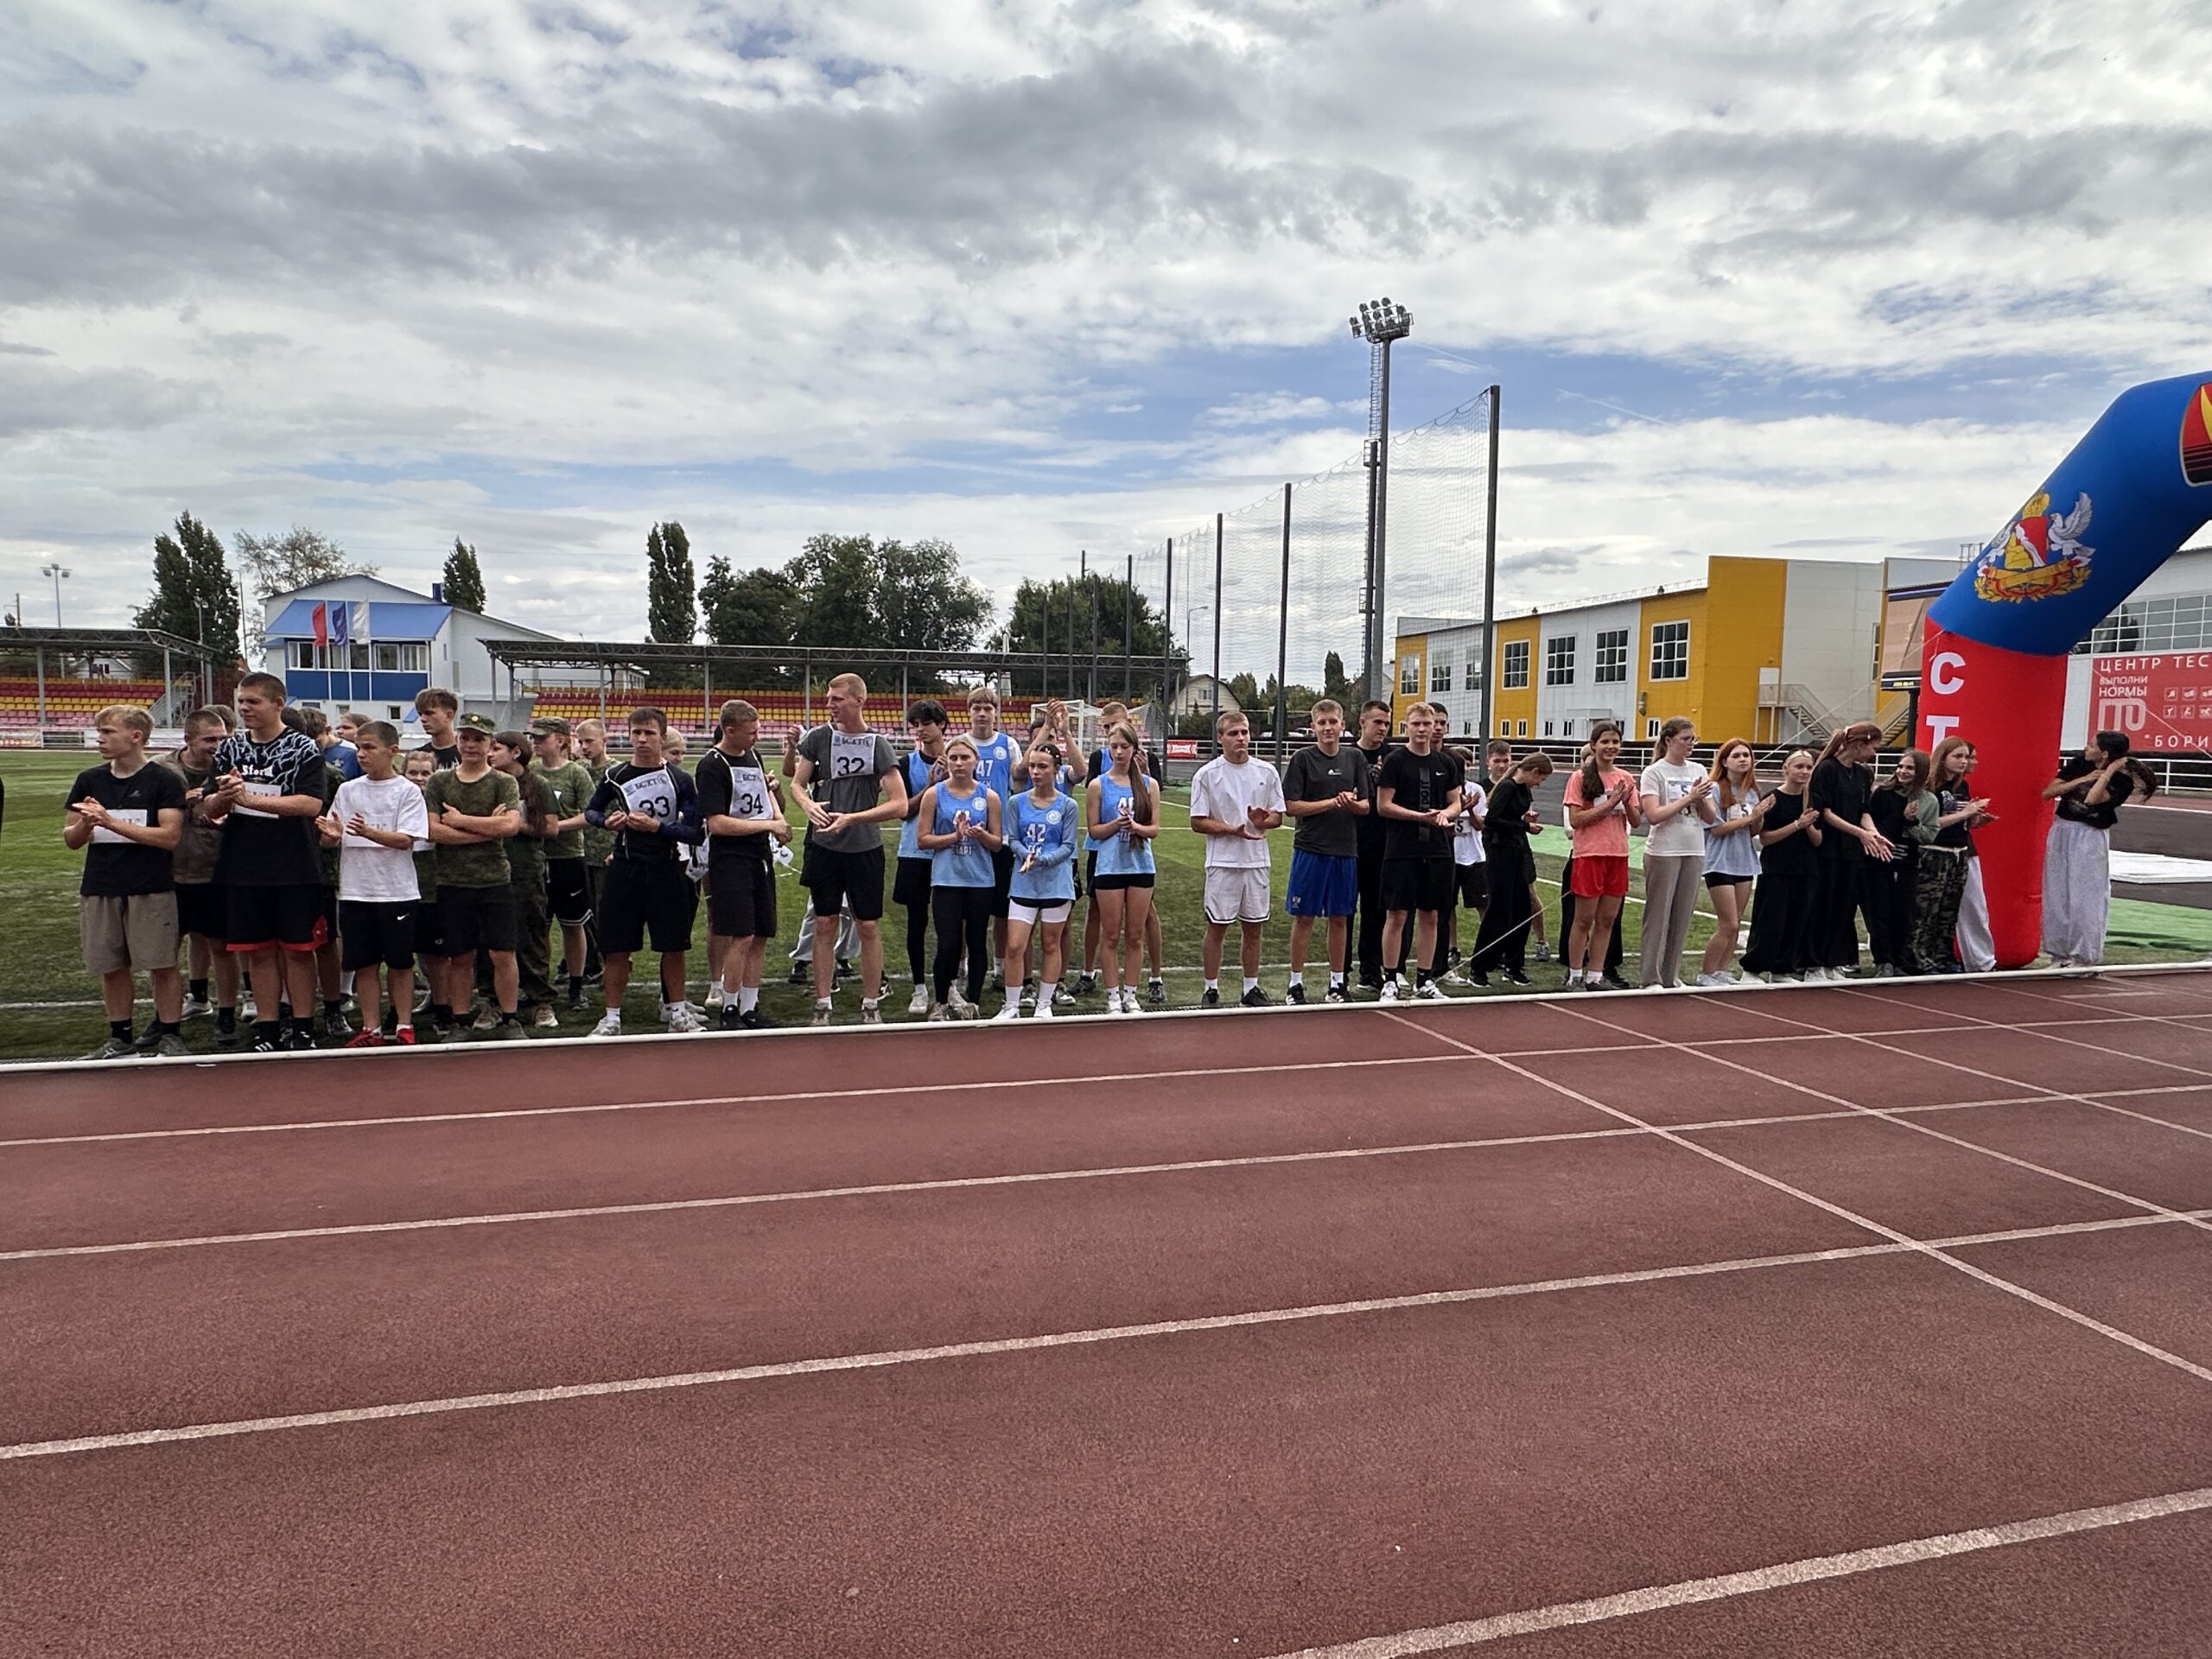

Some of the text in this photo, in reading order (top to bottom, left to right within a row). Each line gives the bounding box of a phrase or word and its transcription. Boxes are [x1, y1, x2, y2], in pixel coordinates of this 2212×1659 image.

[2100, 658, 2161, 673] ЦЕНТР
[2100, 676, 2148, 685] ВЫПОЛНИ
[2099, 686, 2147, 697] НОРМЫ
[836, 756, 865, 776] 32
[976, 760, 994, 777] 47
[639, 796, 670, 817] 33
[740, 793, 763, 814] 34
[1027, 823, 1046, 842] 42
